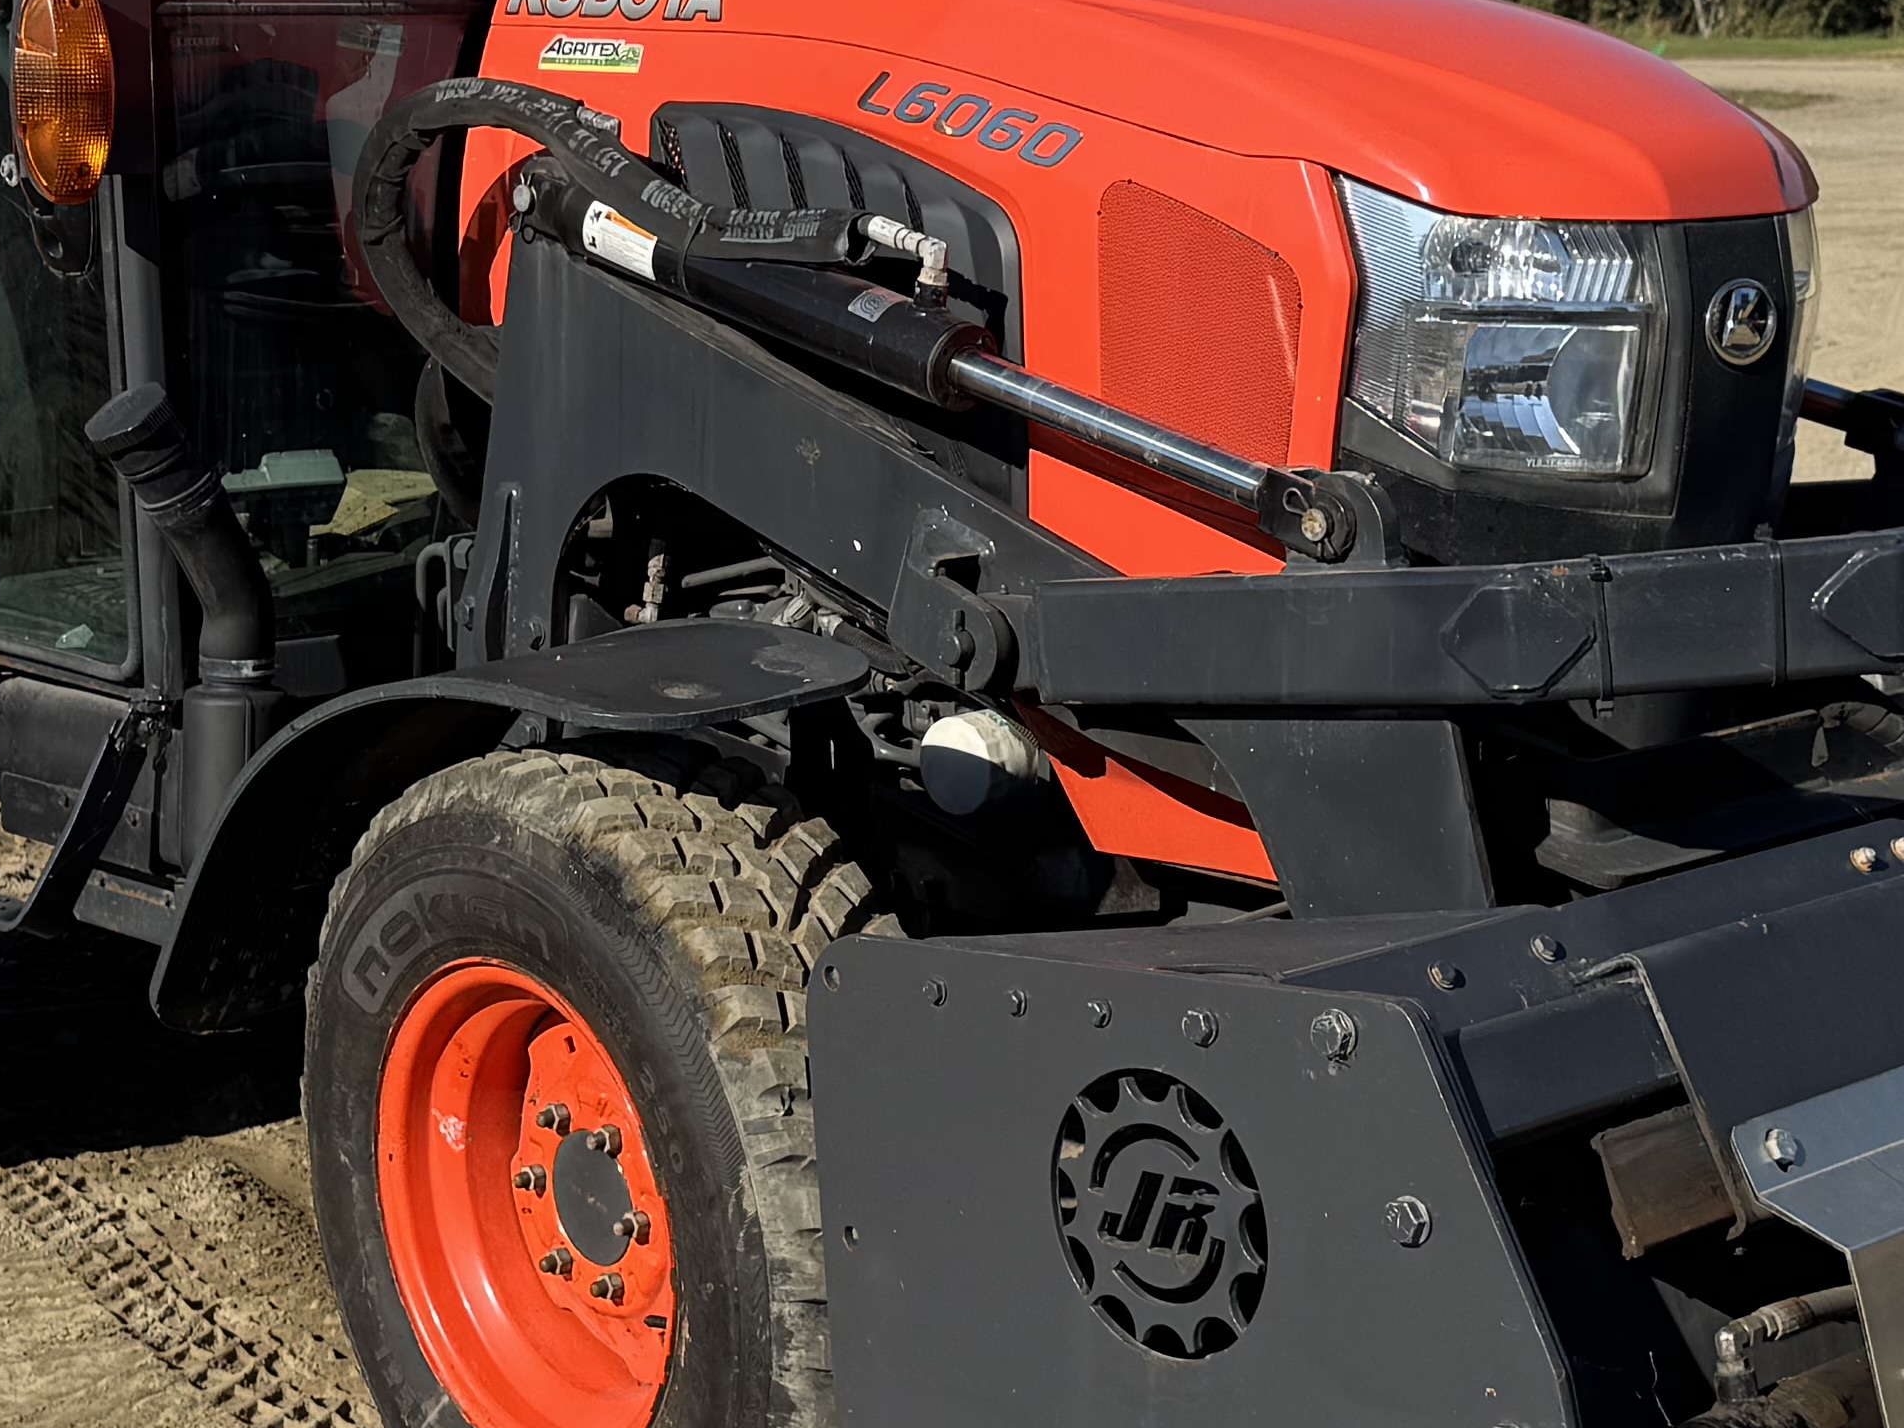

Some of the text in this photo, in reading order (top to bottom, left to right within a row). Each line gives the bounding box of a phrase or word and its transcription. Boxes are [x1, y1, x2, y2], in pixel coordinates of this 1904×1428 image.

[544, 37, 622, 58] AGRITEX
[857, 71, 1084, 168] L6060
[1096, 1169, 1220, 1259] JR
